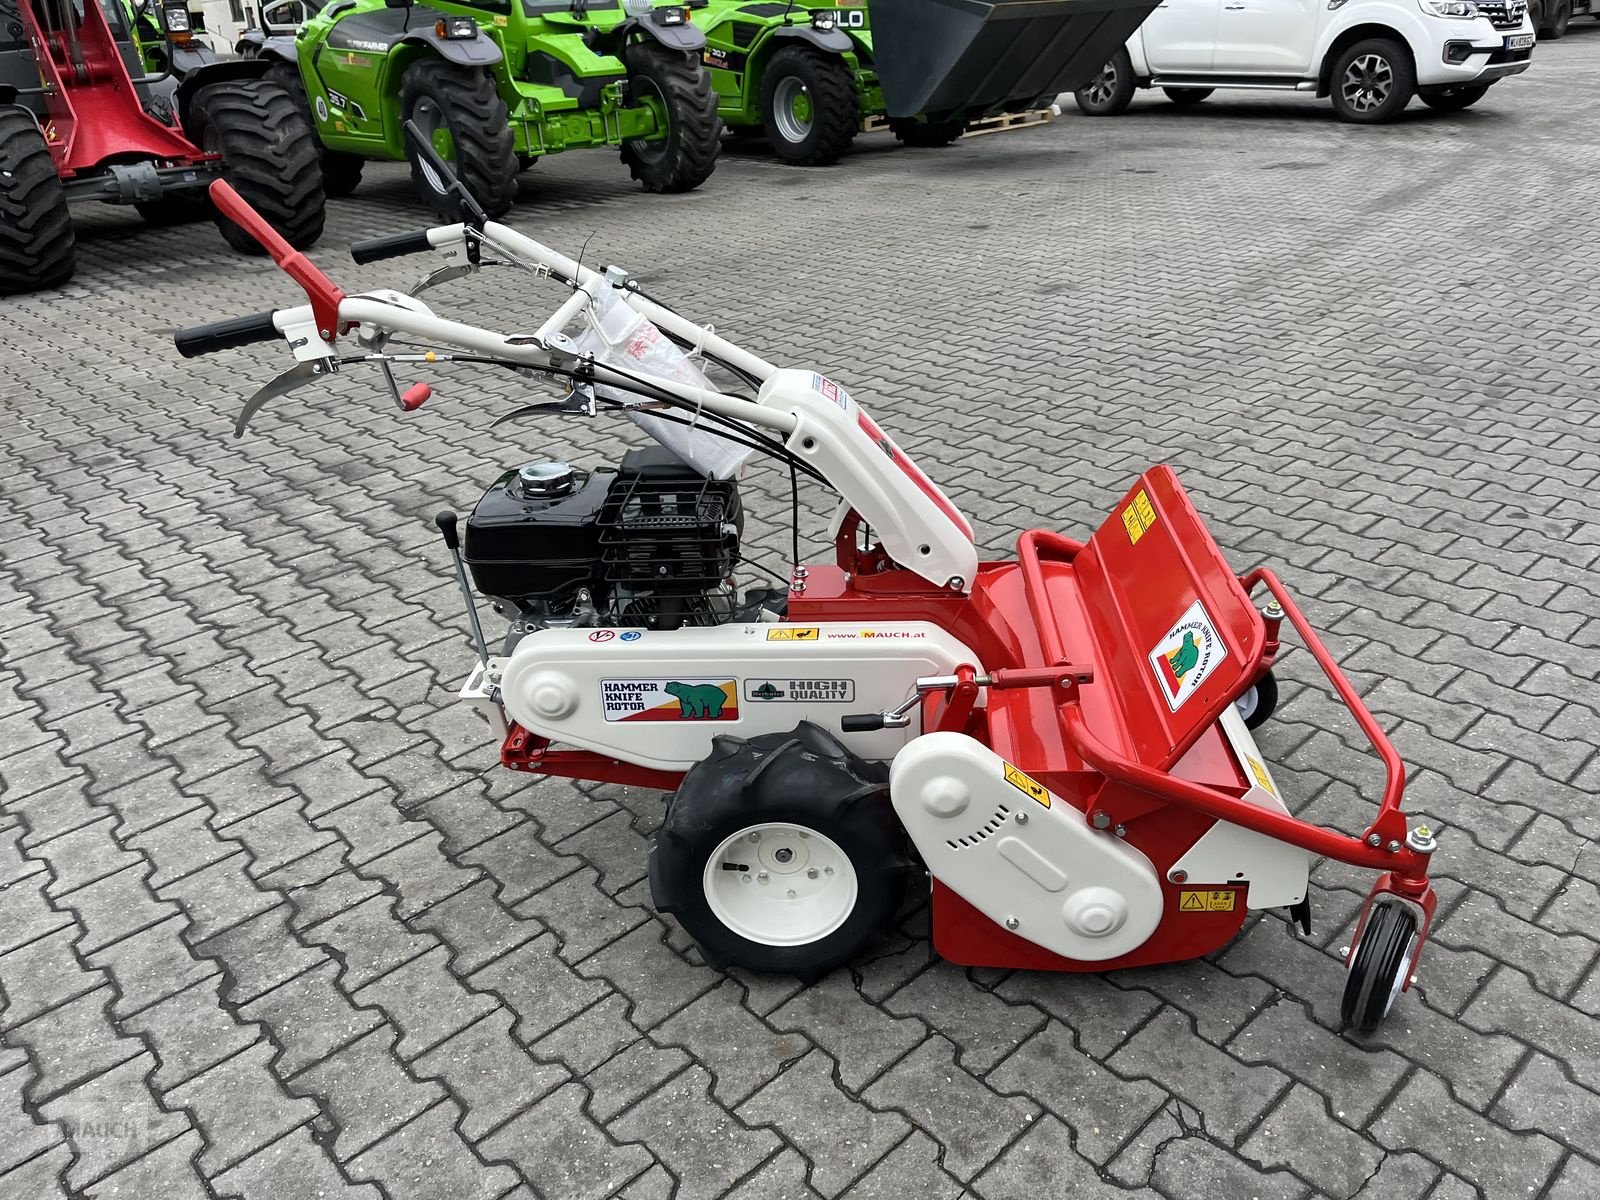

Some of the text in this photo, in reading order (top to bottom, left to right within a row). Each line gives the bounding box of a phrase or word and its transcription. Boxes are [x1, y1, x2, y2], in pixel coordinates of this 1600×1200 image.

[833, 11, 863, 27] LO
[329, 93, 345, 108] 35.7
[1169, 622, 1212, 686] HAMMER KNIFE ROTOR
[603, 683, 659, 692] HAMMER
[789, 681, 847, 690] HIGH
[605, 693, 643, 701] KNIFE
[789, 690, 847, 700] QUALITY
[606, 702, 646, 711] ROTOR
